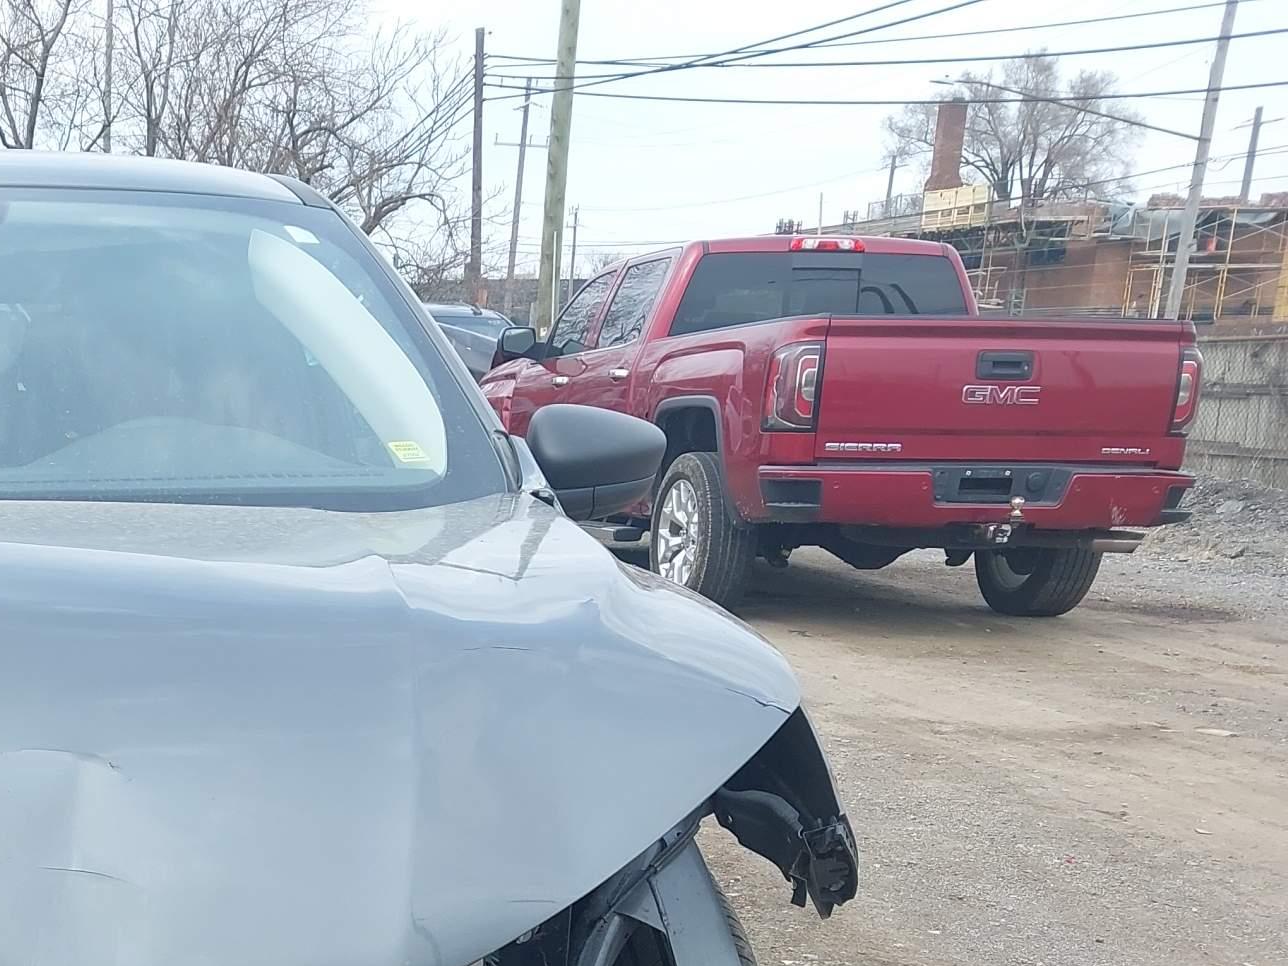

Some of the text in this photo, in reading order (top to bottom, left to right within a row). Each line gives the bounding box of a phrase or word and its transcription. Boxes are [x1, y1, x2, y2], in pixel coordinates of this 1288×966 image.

[962, 385, 1041, 405] GMC
[825, 442, 902, 452] SIERRA
[1101, 447, 1150, 455] DENALI
